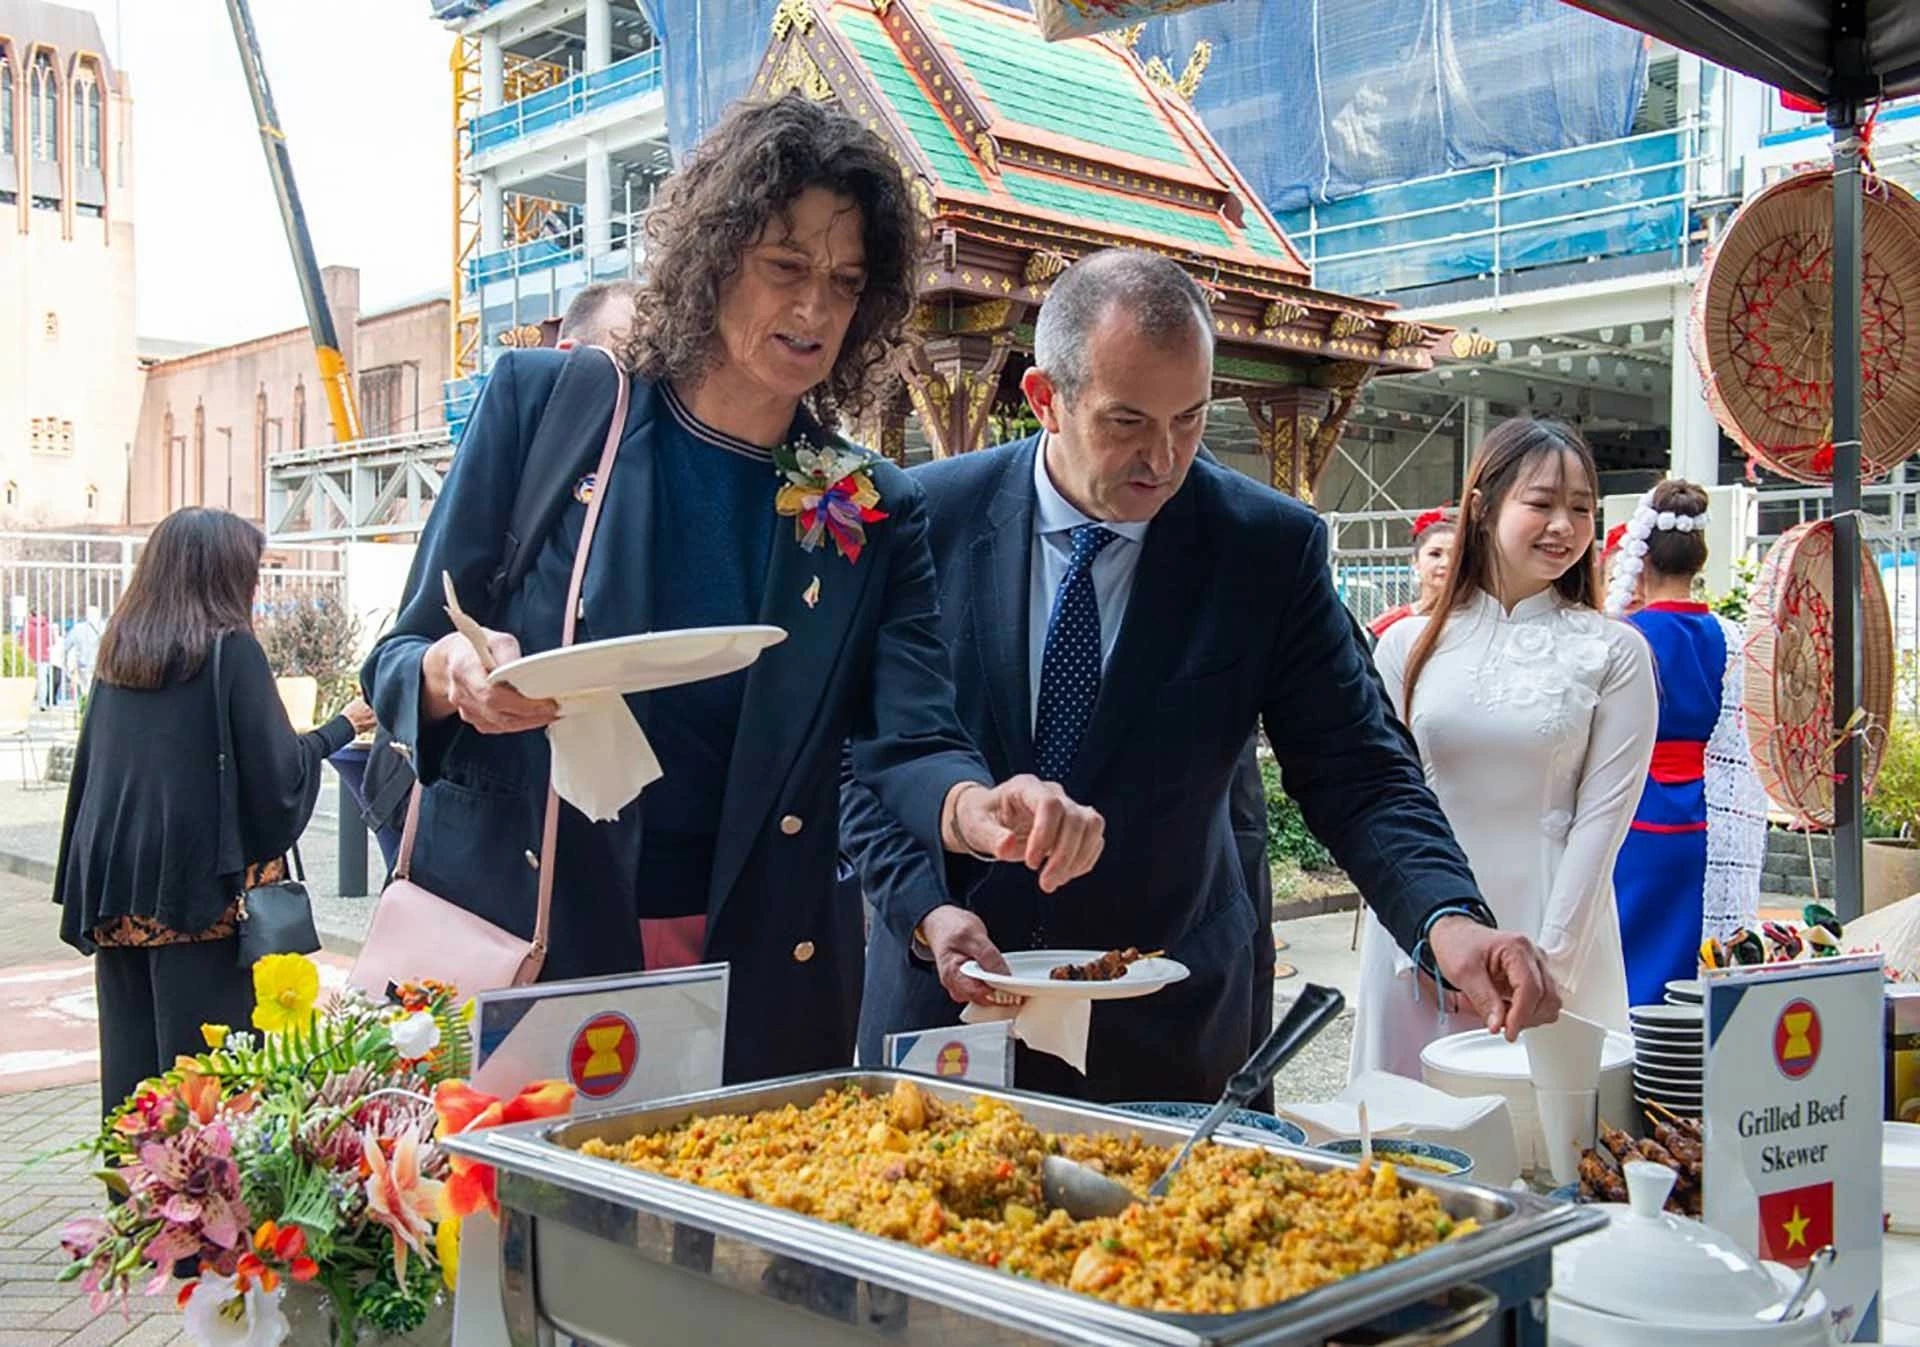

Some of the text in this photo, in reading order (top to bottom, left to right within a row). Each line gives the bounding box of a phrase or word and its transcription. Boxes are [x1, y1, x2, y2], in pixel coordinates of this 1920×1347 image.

[1738, 1094, 1848, 1138] Grilled Beef
[1761, 1144, 1829, 1173] Skewer
